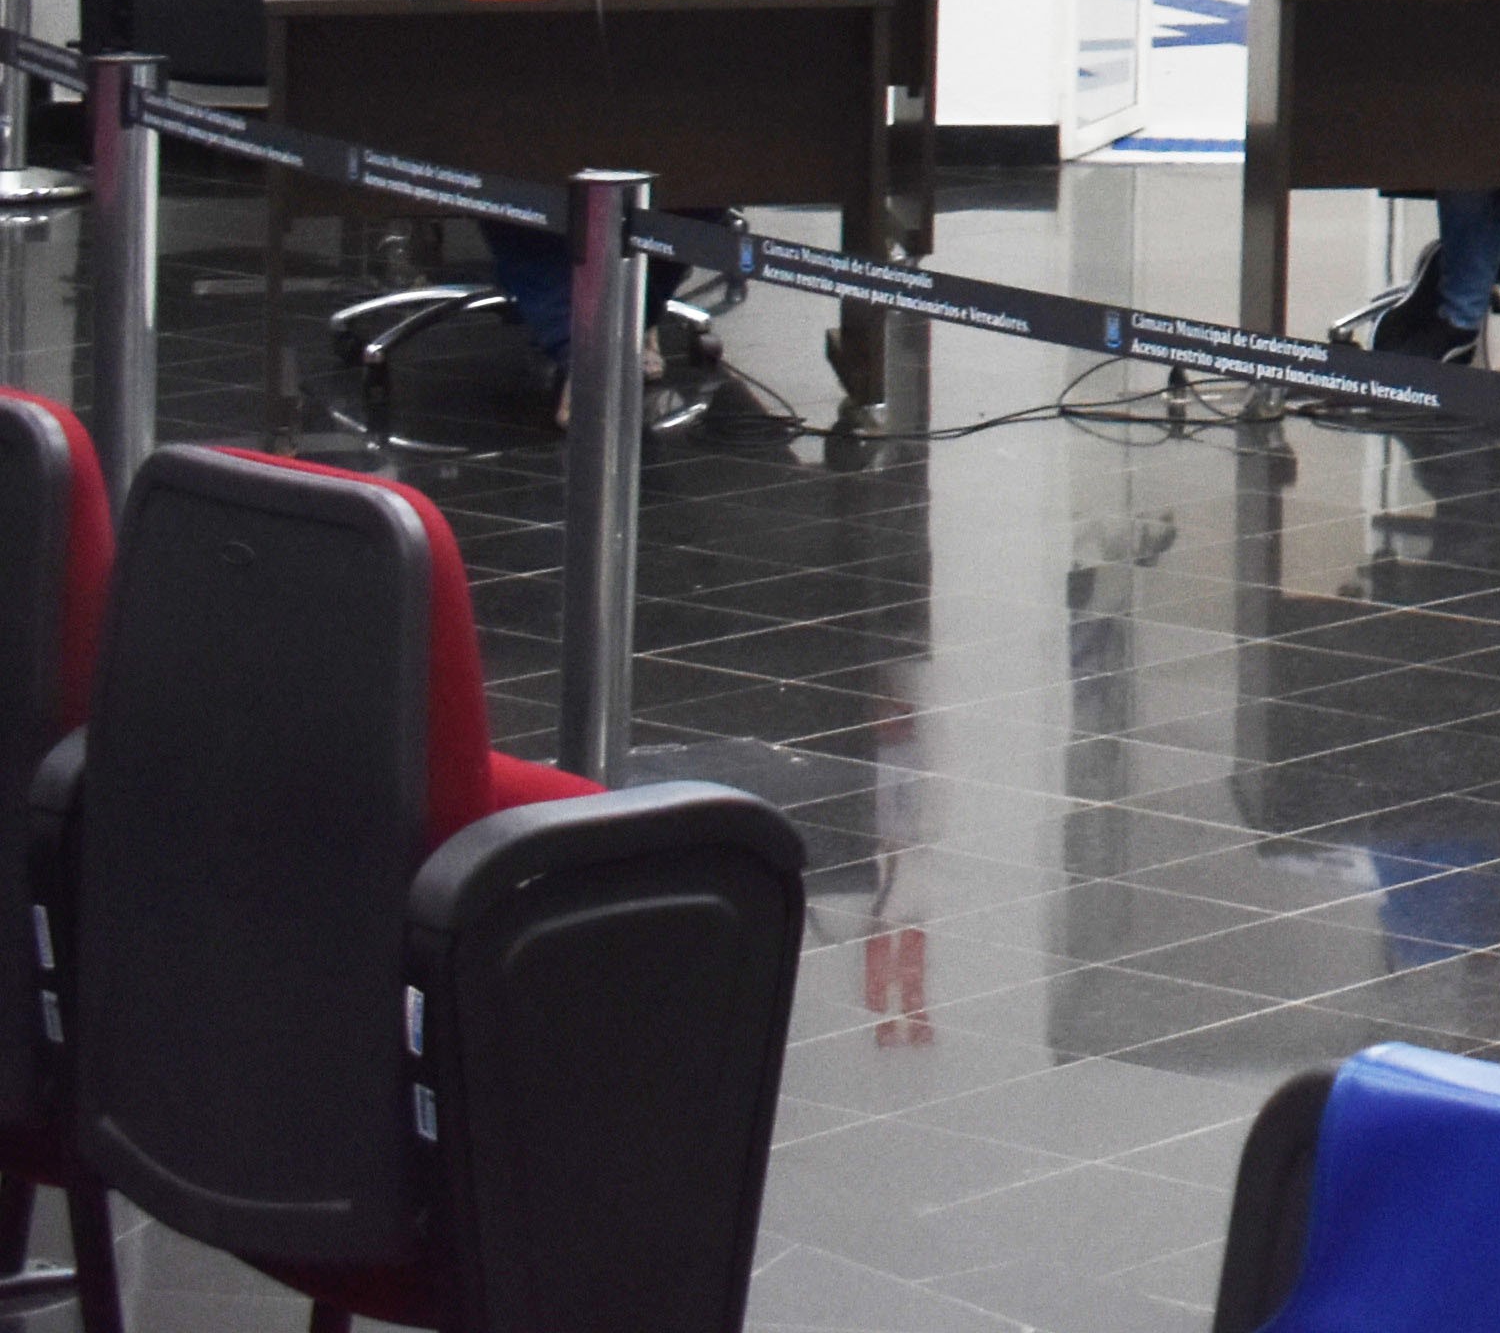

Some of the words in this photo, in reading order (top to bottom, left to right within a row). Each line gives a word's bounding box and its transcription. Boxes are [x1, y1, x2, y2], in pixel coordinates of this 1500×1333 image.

[1132, 311, 1174, 333] Câmara
[1176, 320, 1231, 346] Municipal
[1232, 332, 1247, 346] de
[1249, 334, 1328, 362] Cordeirópolis
[1131, 338, 1170, 358] Acesso
[1171, 345, 1212, 366] restrito
[1214, 356, 1254, 376] apenas
[1257, 362, 1283, 382] para
[1286, 367, 1358, 392] funcionários
[1360, 381, 1368, 394] e
[1370, 381, 1440, 407] Vereadores.
